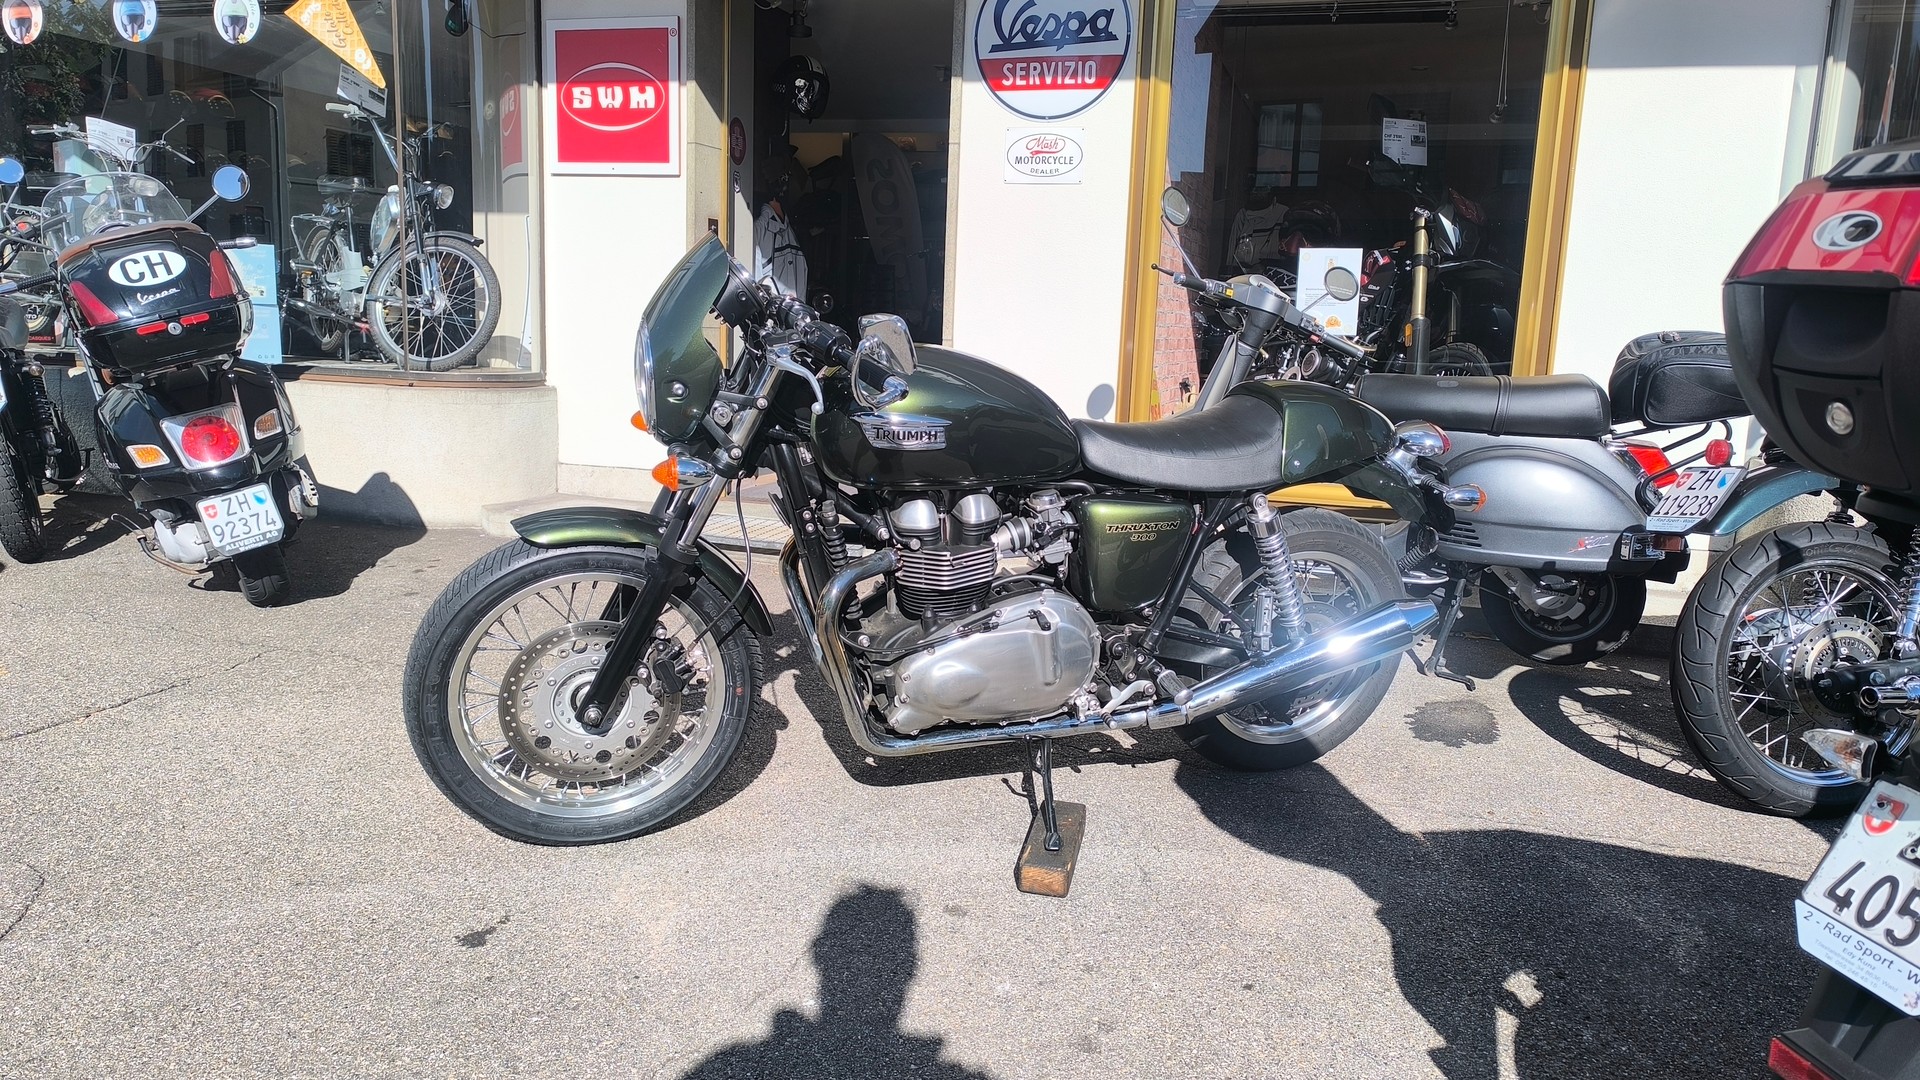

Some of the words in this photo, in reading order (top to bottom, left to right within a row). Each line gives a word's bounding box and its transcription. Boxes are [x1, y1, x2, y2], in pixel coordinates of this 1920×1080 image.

[988, 0, 1119, 53] Vespa
[1001, 61, 1097, 86] SERVIZIO
[571, 85, 656, 109] SWM
[1014, 155, 1074, 165] MOTORCYCLE
[1030, 167, 1060, 175] DEALER
[119, 252, 174, 284] CH
[136, 288, 181, 305] Vespa
[872, 426, 938, 443] TRIUMPH
[1687, 470, 1722, 491] ZH
[221, 493, 251, 516] ZH
[1654, 494, 1719, 516] 119238
[212, 510, 277, 543] 92374
[1106, 520, 1181, 533] THRUXTON
[1130, 532, 1157, 541] 900
[225, 535, 264, 551] ALIVERTI
[1823, 860, 1920, 948] 405
[1803, 910, 1814, 921] 2
[1823, 922, 1852, 944] Rad
[1853, 940, 1895, 970] Sport
[1842, 947, 1856, 959] Edy
[1858, 957, 1877, 971] Kunz
